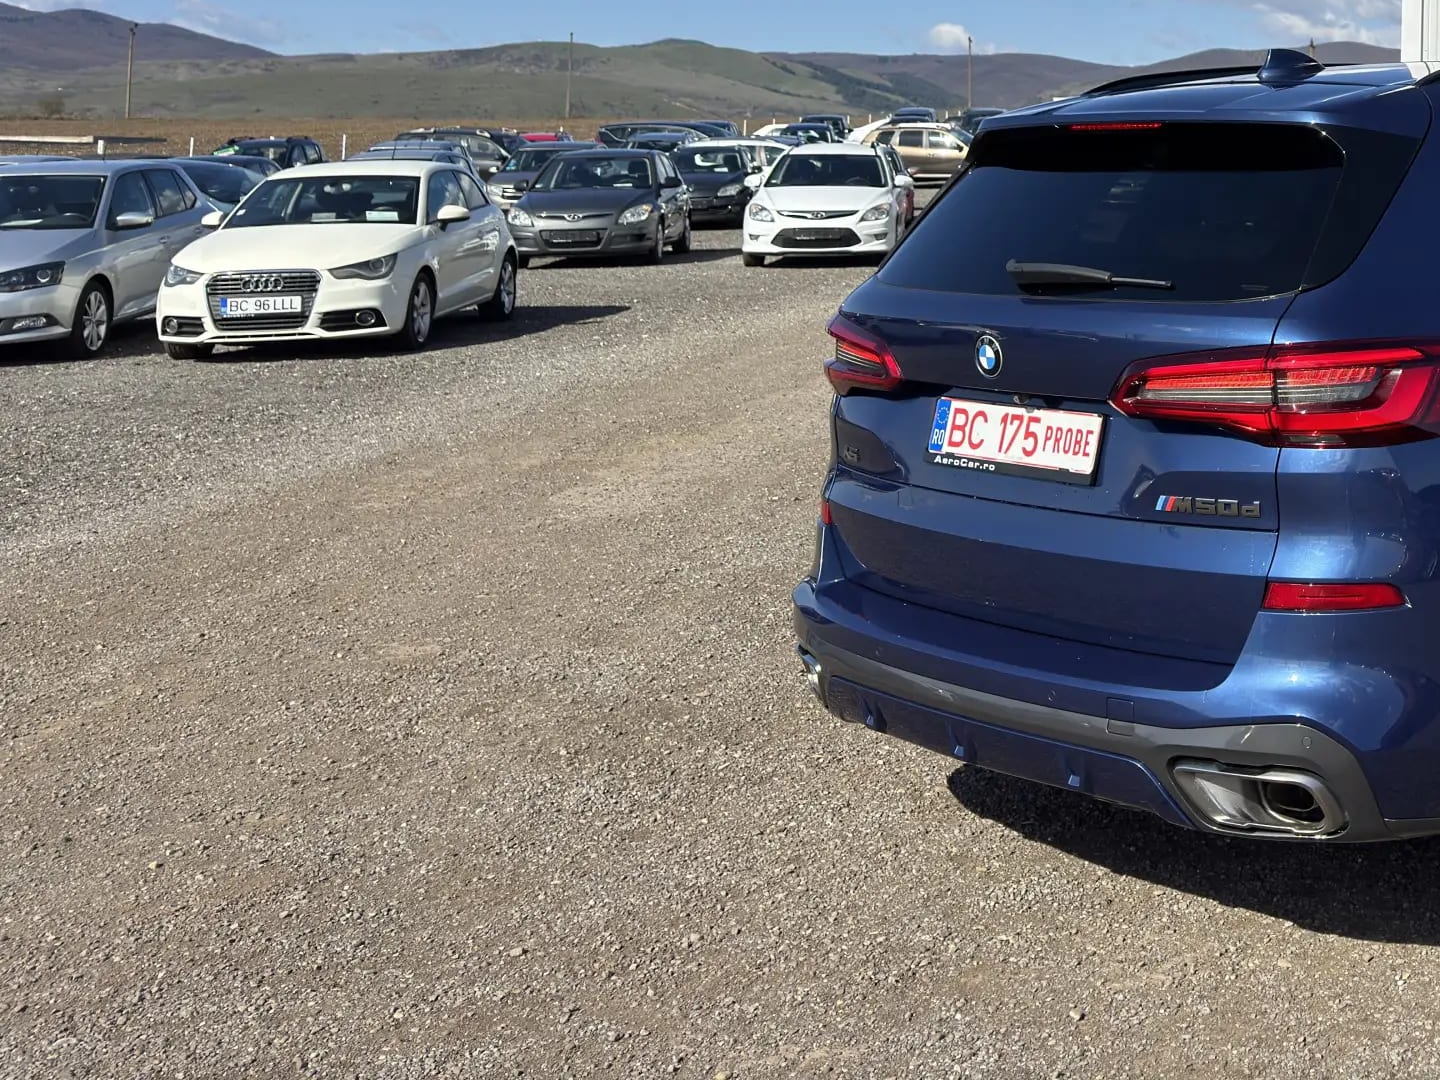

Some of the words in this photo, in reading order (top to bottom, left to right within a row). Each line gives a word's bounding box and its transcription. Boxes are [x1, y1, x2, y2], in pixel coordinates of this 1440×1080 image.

[229, 300, 249, 312] BC
[254, 299, 270, 311] 96
[273, 298, 298, 311] LLL
[931, 428, 945, 445] RO
[947, 407, 988, 450] BC
[997, 412, 1042, 458] 175
[1042, 425, 1094, 458] PROBE
[933, 454, 996, 471] AeroCar.ro
